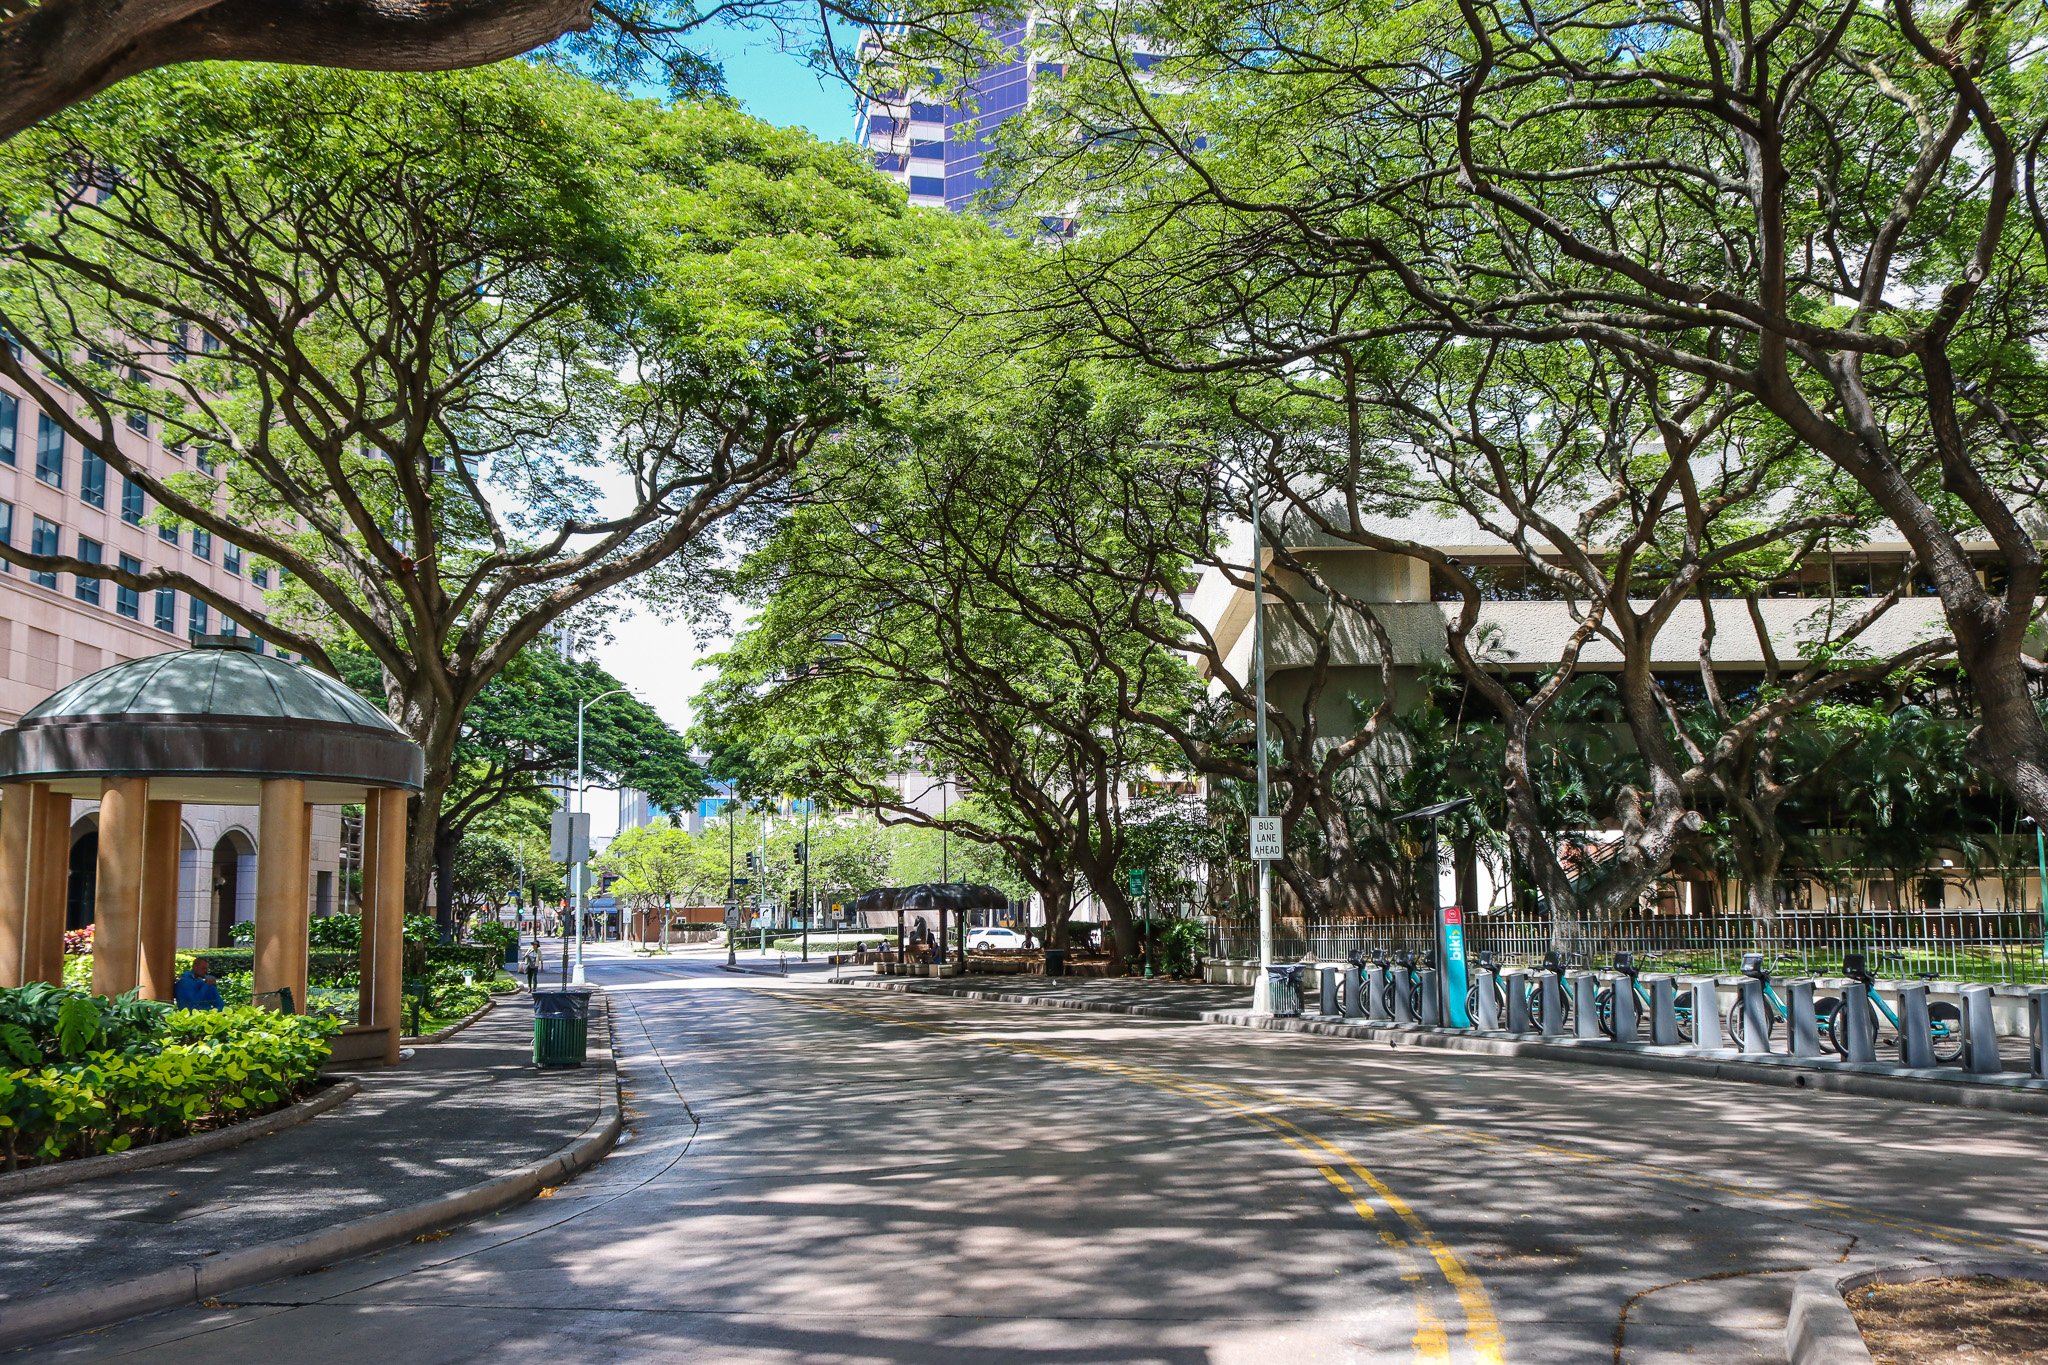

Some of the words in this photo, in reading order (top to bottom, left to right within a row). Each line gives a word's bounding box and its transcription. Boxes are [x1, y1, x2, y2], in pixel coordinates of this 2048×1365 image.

[1258, 821, 1274, 831] BUS
[1256, 833, 1277, 843] LANE
[1254, 845, 1280, 855] AHEAD
[1449, 934, 1462, 961] biki
